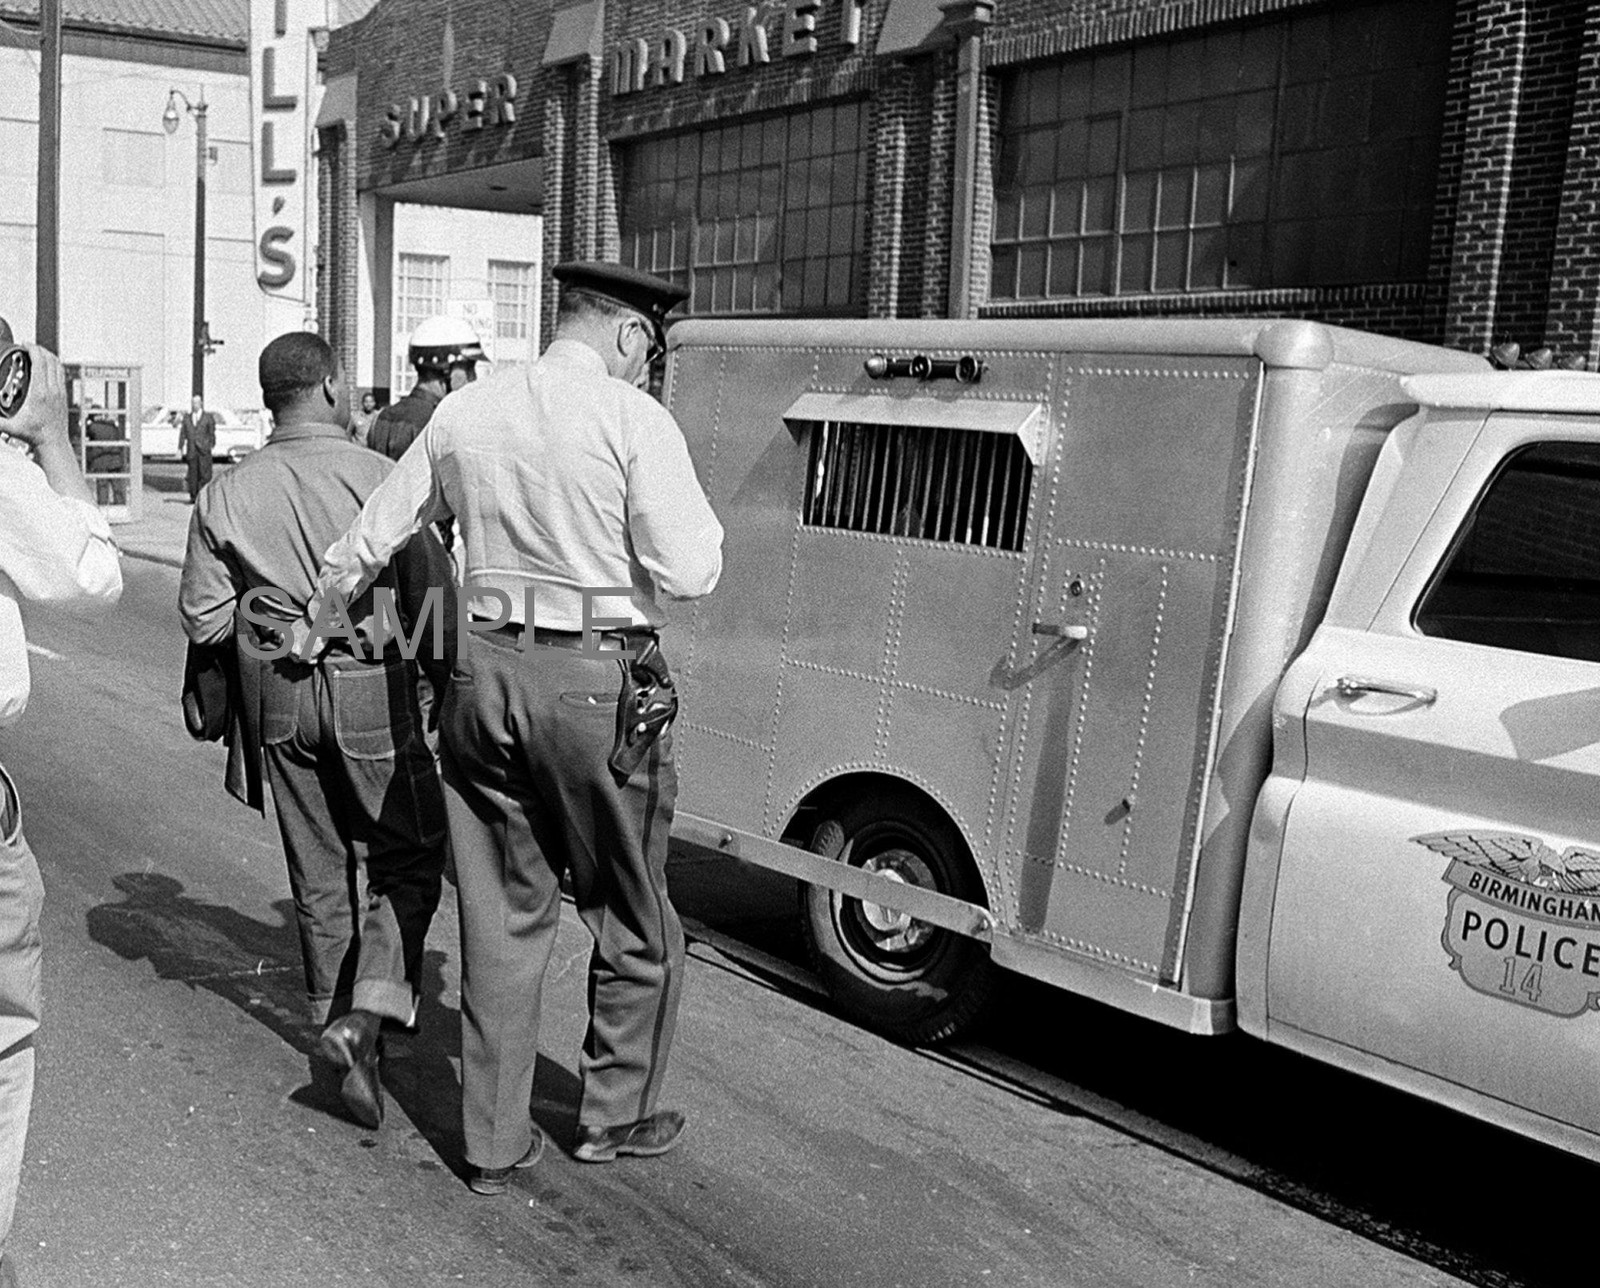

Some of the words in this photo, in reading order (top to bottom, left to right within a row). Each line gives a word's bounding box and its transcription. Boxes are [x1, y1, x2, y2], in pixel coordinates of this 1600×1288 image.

[380, 73, 517, 147] SUPER
[1461, 910, 1600, 977] POLICE
[1499, 957, 1543, 1002] 14
